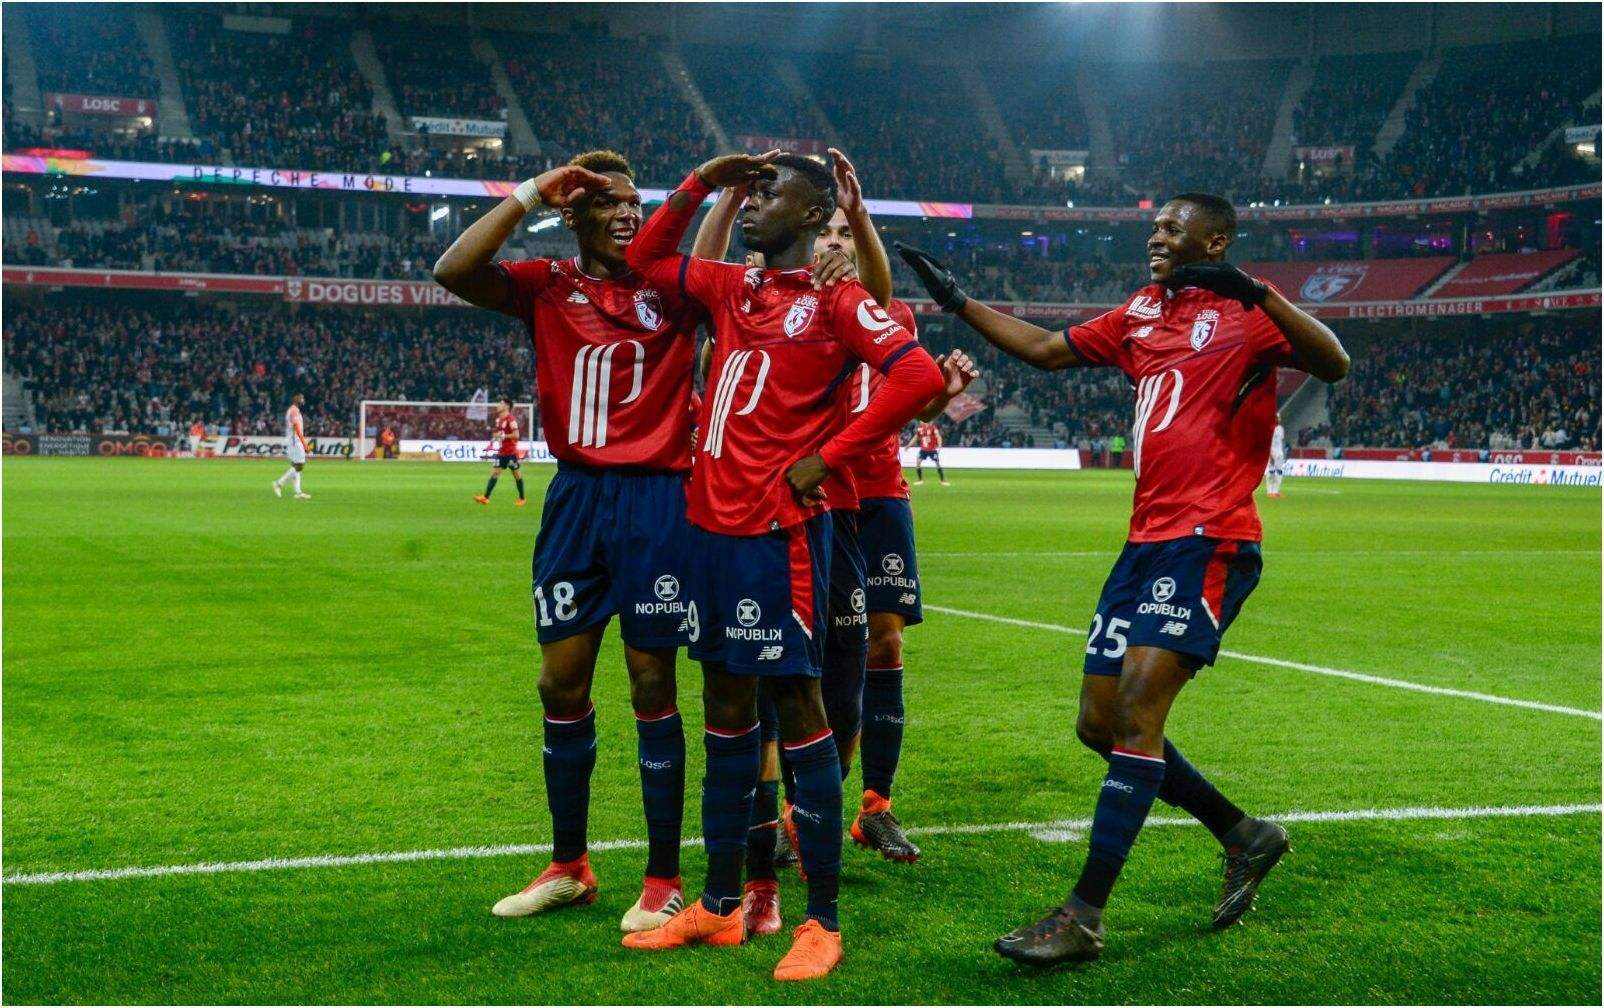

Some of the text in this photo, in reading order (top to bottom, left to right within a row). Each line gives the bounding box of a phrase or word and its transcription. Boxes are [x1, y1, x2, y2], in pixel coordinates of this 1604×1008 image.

[82, 97, 120, 112] LOSC
[193, 166, 413, 192] DEPECHE MODE
[308, 284, 402, 304] DOGUES
[795, 298, 819, 308] LOSC
[1197, 313, 1220, 321] LOSC
[1307, 463, 1345, 478] Mutuel
[1489, 467, 1602, 486] Crédit Mutuel
[534, 581, 578, 627] 18
[687, 600, 700, 643] 9
[1086, 613, 1131, 658] 25
